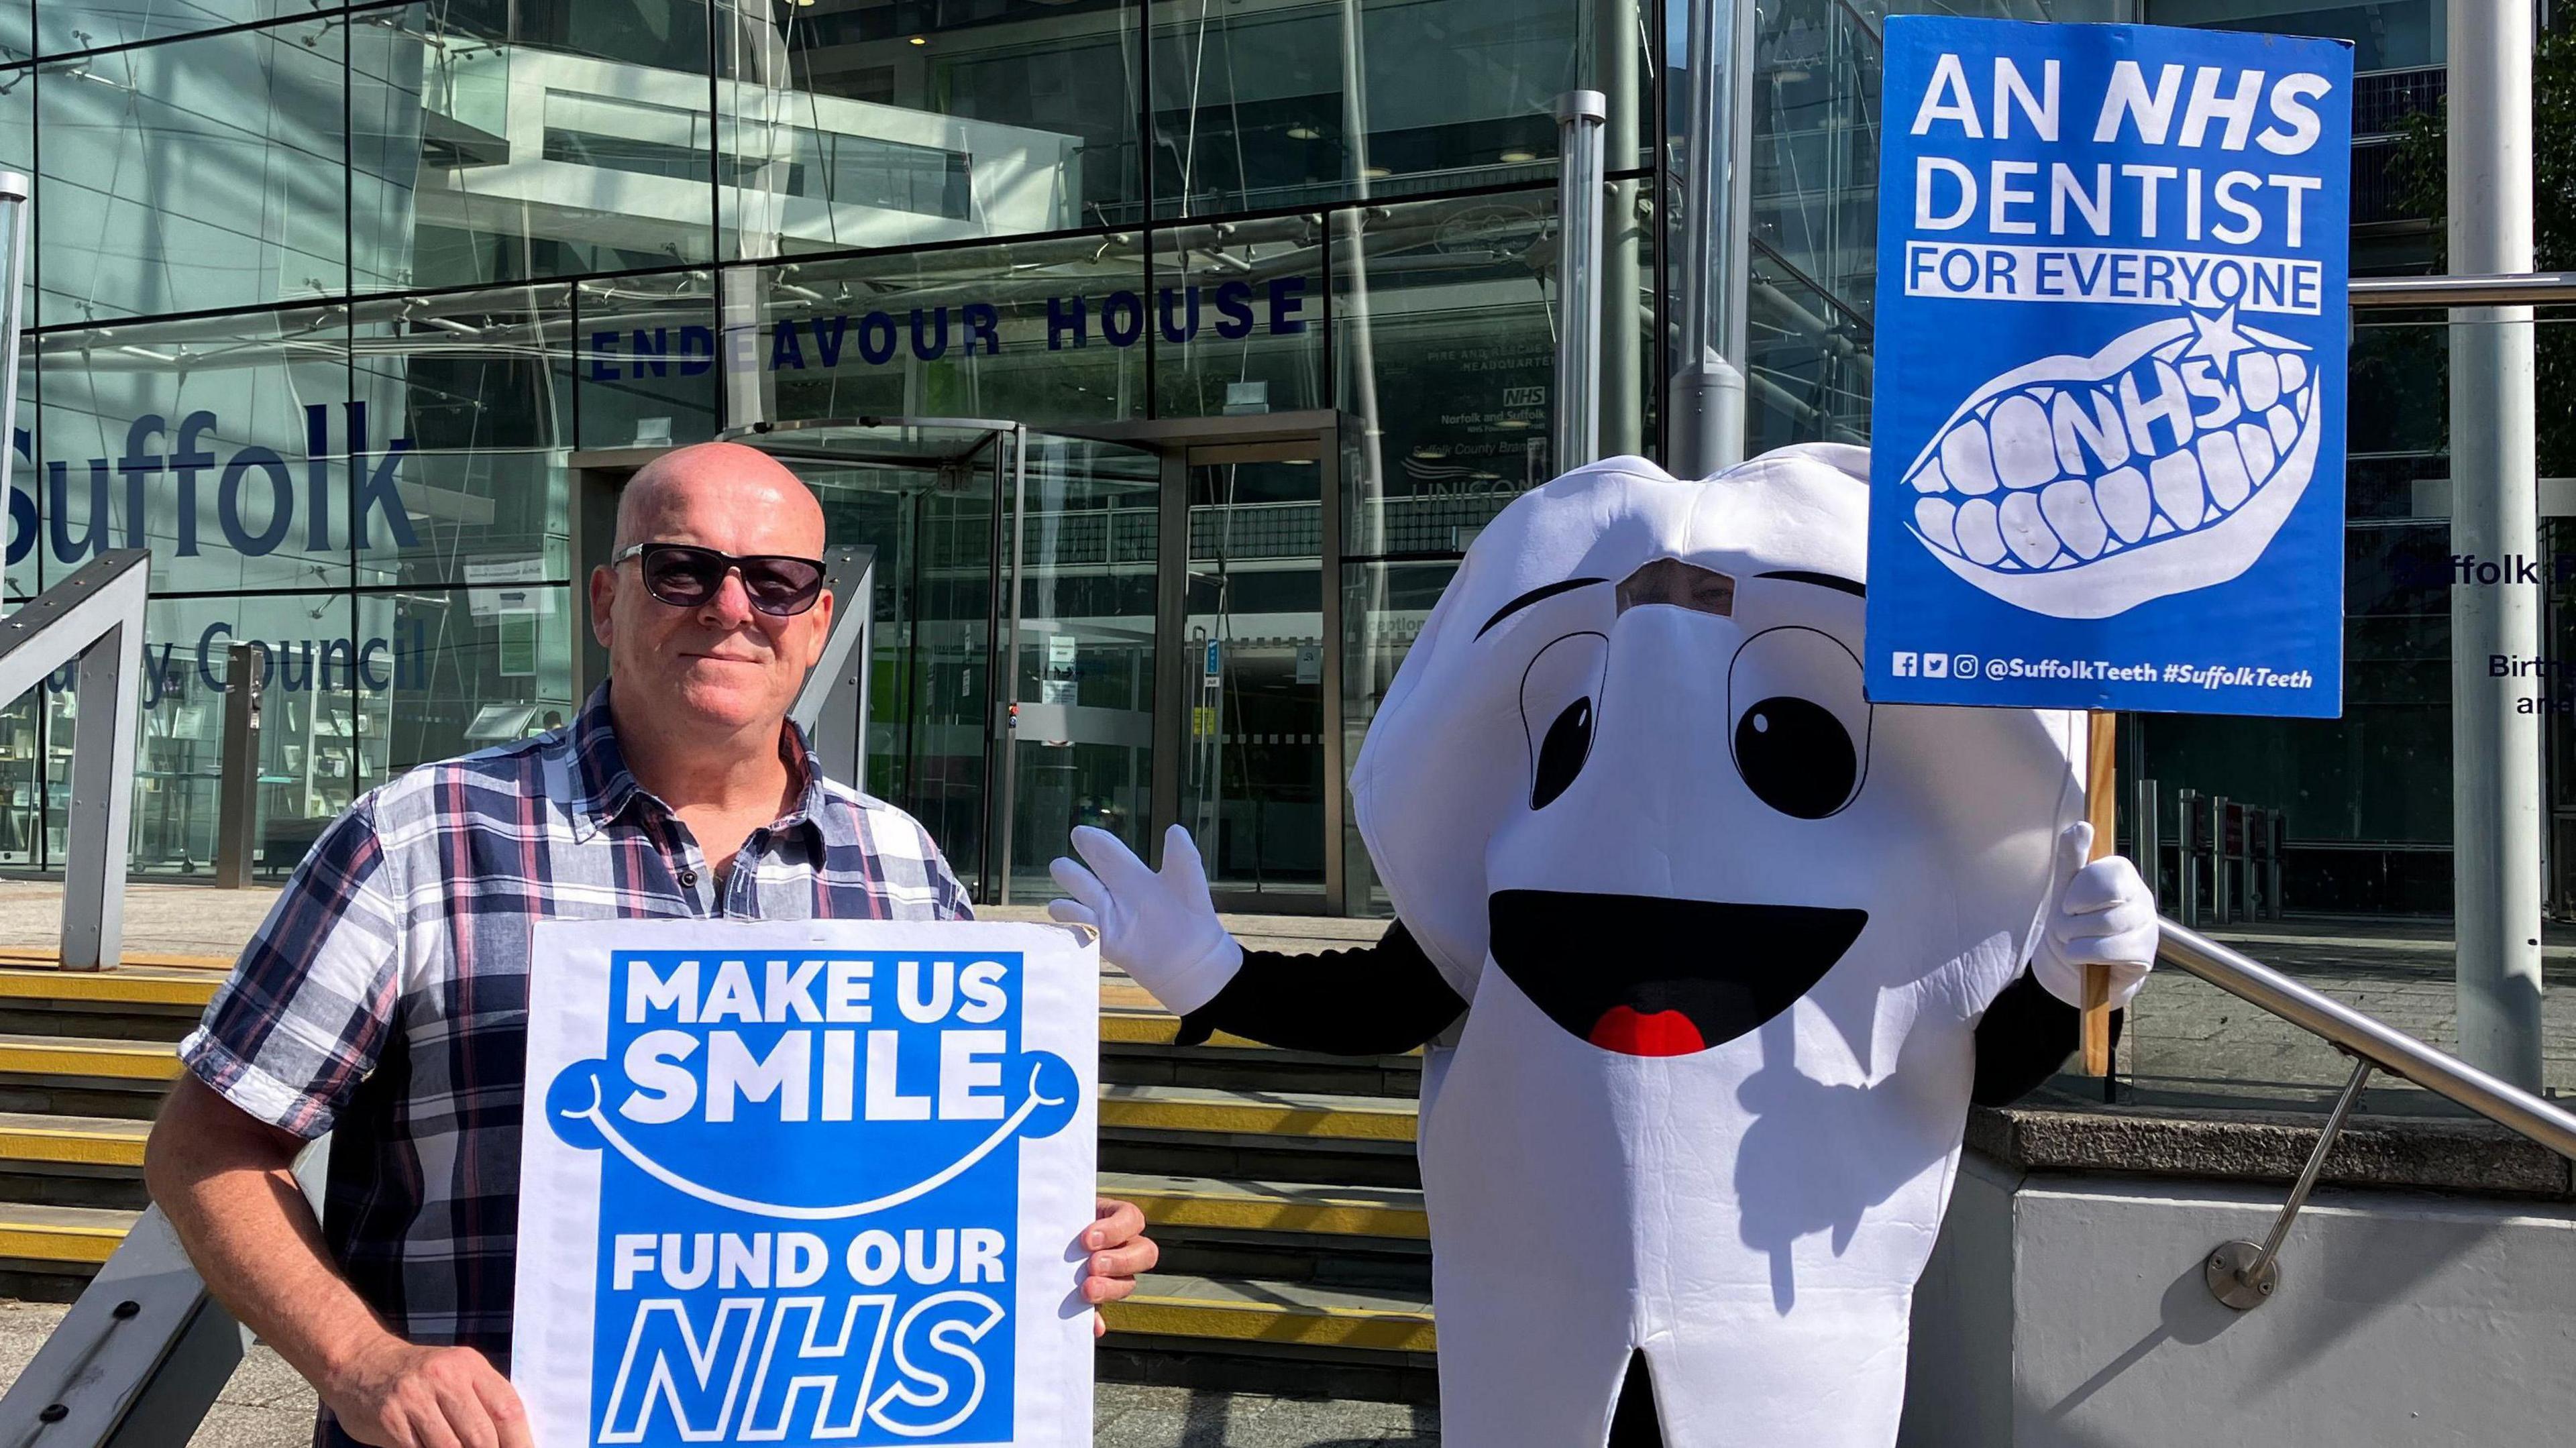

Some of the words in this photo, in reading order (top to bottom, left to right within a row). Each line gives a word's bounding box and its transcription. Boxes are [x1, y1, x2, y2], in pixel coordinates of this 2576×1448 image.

[1911, 53, 2060, 142] AN
[2093, 60, 2332, 155] NHS
[1915, 156, 2322, 248] DENTIST
[1911, 246, 2016, 294] FOR
[2036, 252, 2316, 310] EVERYONE
[592, 302, 1001, 382] ENDEAVOUR
[1047, 276, 1307, 353] HOUSE
[1427, 351, 1455, 361] FIRE
[1461, 349, 1488, 360] AND
[1442, 412, 1481, 424] Norfolk
[1484, 411, 1503, 421] and
[1507, 409, 1545, 420] Suffolk
[1506, 388, 1543, 404] NHS
[2051, 356, 2242, 476] NHS
[5, 401, 420, 565] Suffolk
[1413, 445, 1450, 457] Suffolk
[1454, 443, 1495, 459] County
[198, 619, 426, 693] Council
[1985, 658, 2157, 681] @SuffolkTeeth
[2163, 664, 2313, 689] #SuffolkTeeth
[625, 960, 873, 1023] MAKE
[896, 960, 1008, 1024] US
[619, 1029, 1008, 1124] SMILE
[612, 1232, 829, 1290] FUND
[847, 1228, 1005, 1289] OUR
[598, 1290, 1006, 1444] NHS
